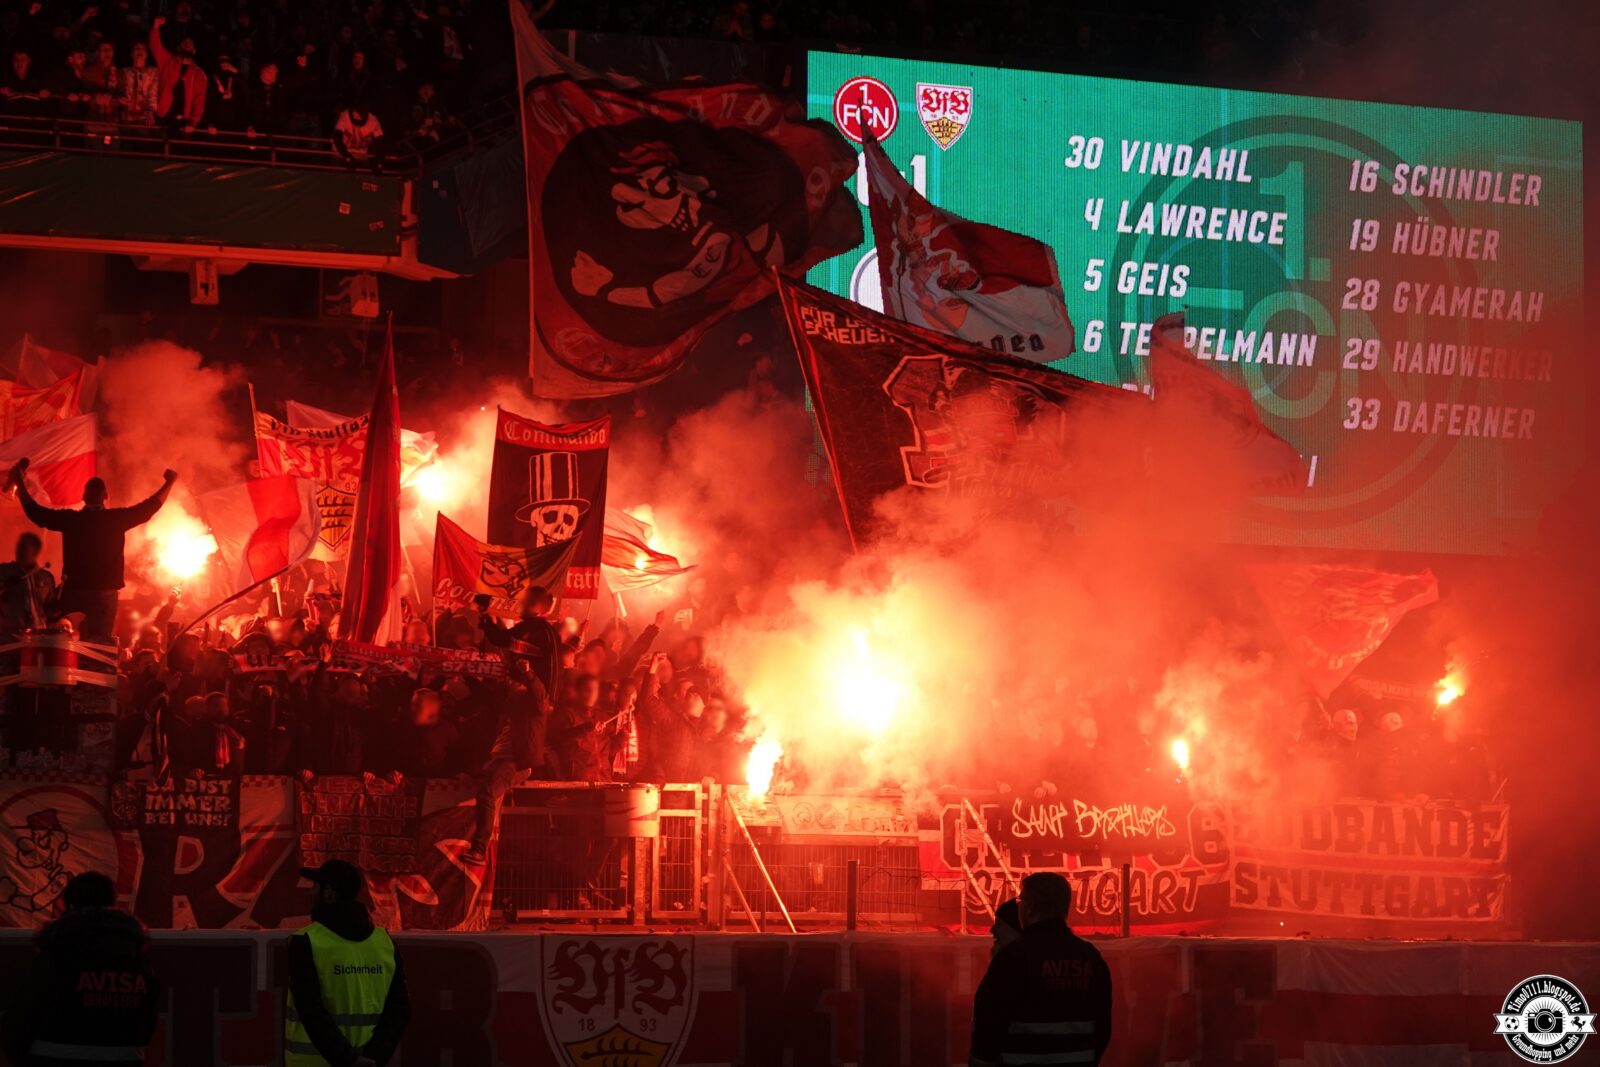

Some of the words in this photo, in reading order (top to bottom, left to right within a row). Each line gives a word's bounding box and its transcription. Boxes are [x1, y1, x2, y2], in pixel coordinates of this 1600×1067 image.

[1065, 136, 1103, 169] 30
[1121, 140, 1253, 183] VINDAHL
[1349, 160, 1380, 193] 16
[1392, 164, 1542, 207] SCHINDLER
[1085, 198, 1103, 231] 4
[1117, 200, 1288, 245] LAWRENCE
[1349, 219, 1380, 252] 19
[1393, 217, 1500, 262] HÜBNER
[1084, 259, 1104, 292] 5
[1117, 261, 1190, 298] GEIS
[1342, 278, 1380, 311] 28
[1392, 282, 1545, 322] GYAMERAH
[1083, 320, 1105, 353] 6
[1119, 321, 1318, 367] TEPELMANN
[1343, 338, 1380, 370] 29
[1392, 341, 1553, 382] HANDWERKER
[1343, 397, 1380, 430] 33
[1393, 399, 1536, 441] DAFERNER
[145, 793, 232, 812] IMMER
[185, 778, 232, 794] BIST
[144, 812, 175, 825] BEI
[964, 867, 1207, 917] STTGART
[1233, 861, 1496, 917] STUTTGART
[77, 971, 147, 993] AVISA
[333, 964, 384, 976] Sicherheit
[1041, 960, 1094, 977] AVISA
[578, 1018, 596, 1032] 18
[639, 1018, 657, 1032] 93
